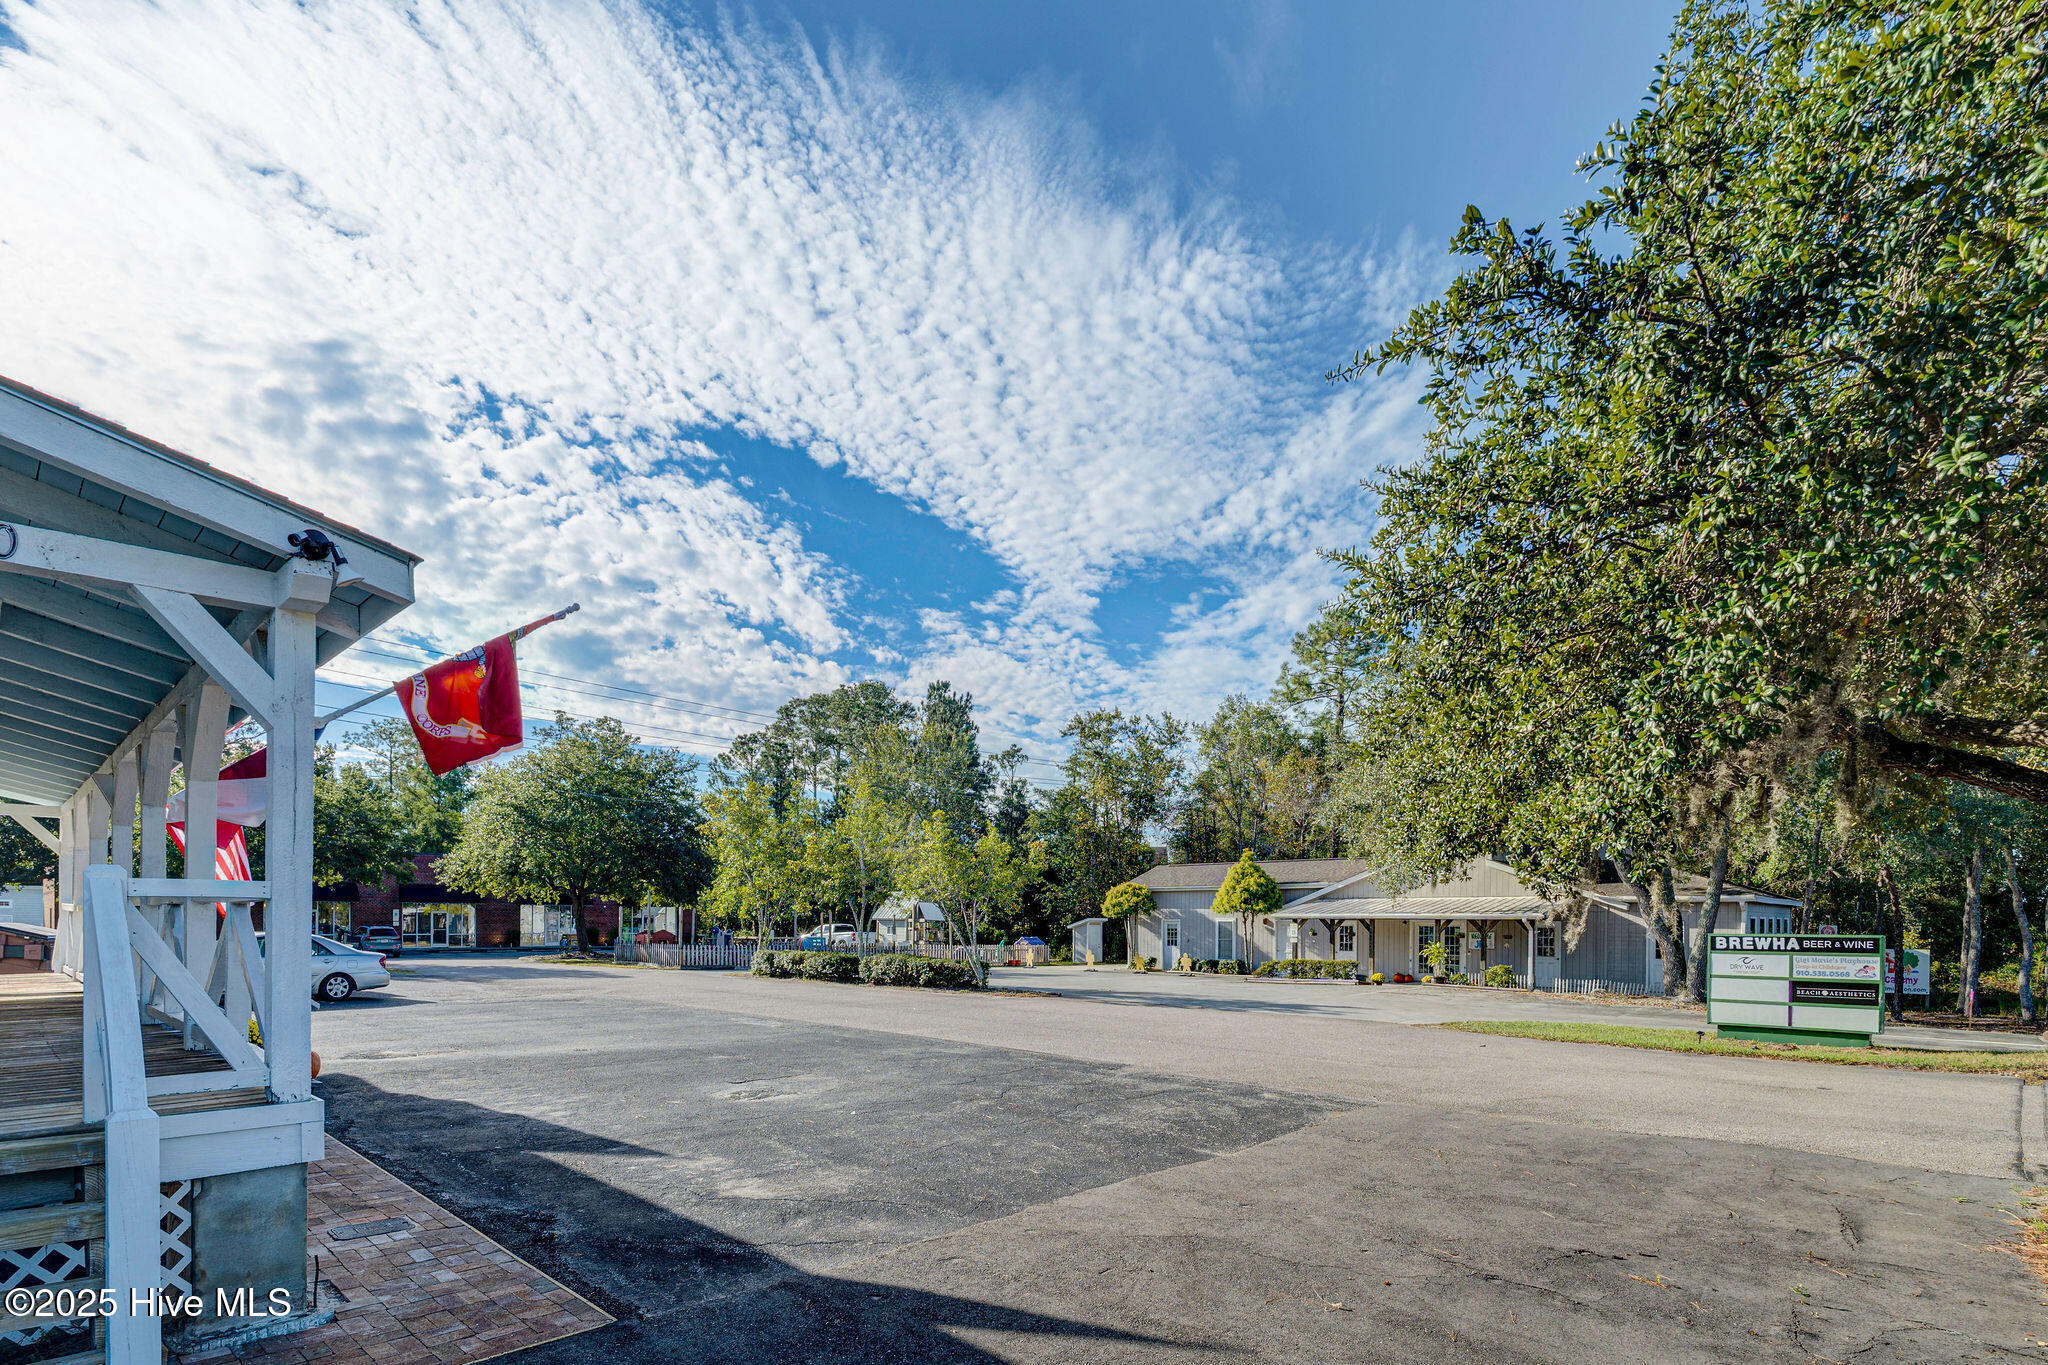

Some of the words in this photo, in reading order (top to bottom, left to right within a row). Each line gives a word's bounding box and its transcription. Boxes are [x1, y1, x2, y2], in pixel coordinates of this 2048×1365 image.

[417, 713, 452, 737] CORPS
[1715, 936, 1800, 950] BREWHA
[1803, 940, 1832, 948] BEER
[1843, 940, 1875, 949] WINE
[1840, 957, 1878, 966] Playhouse
